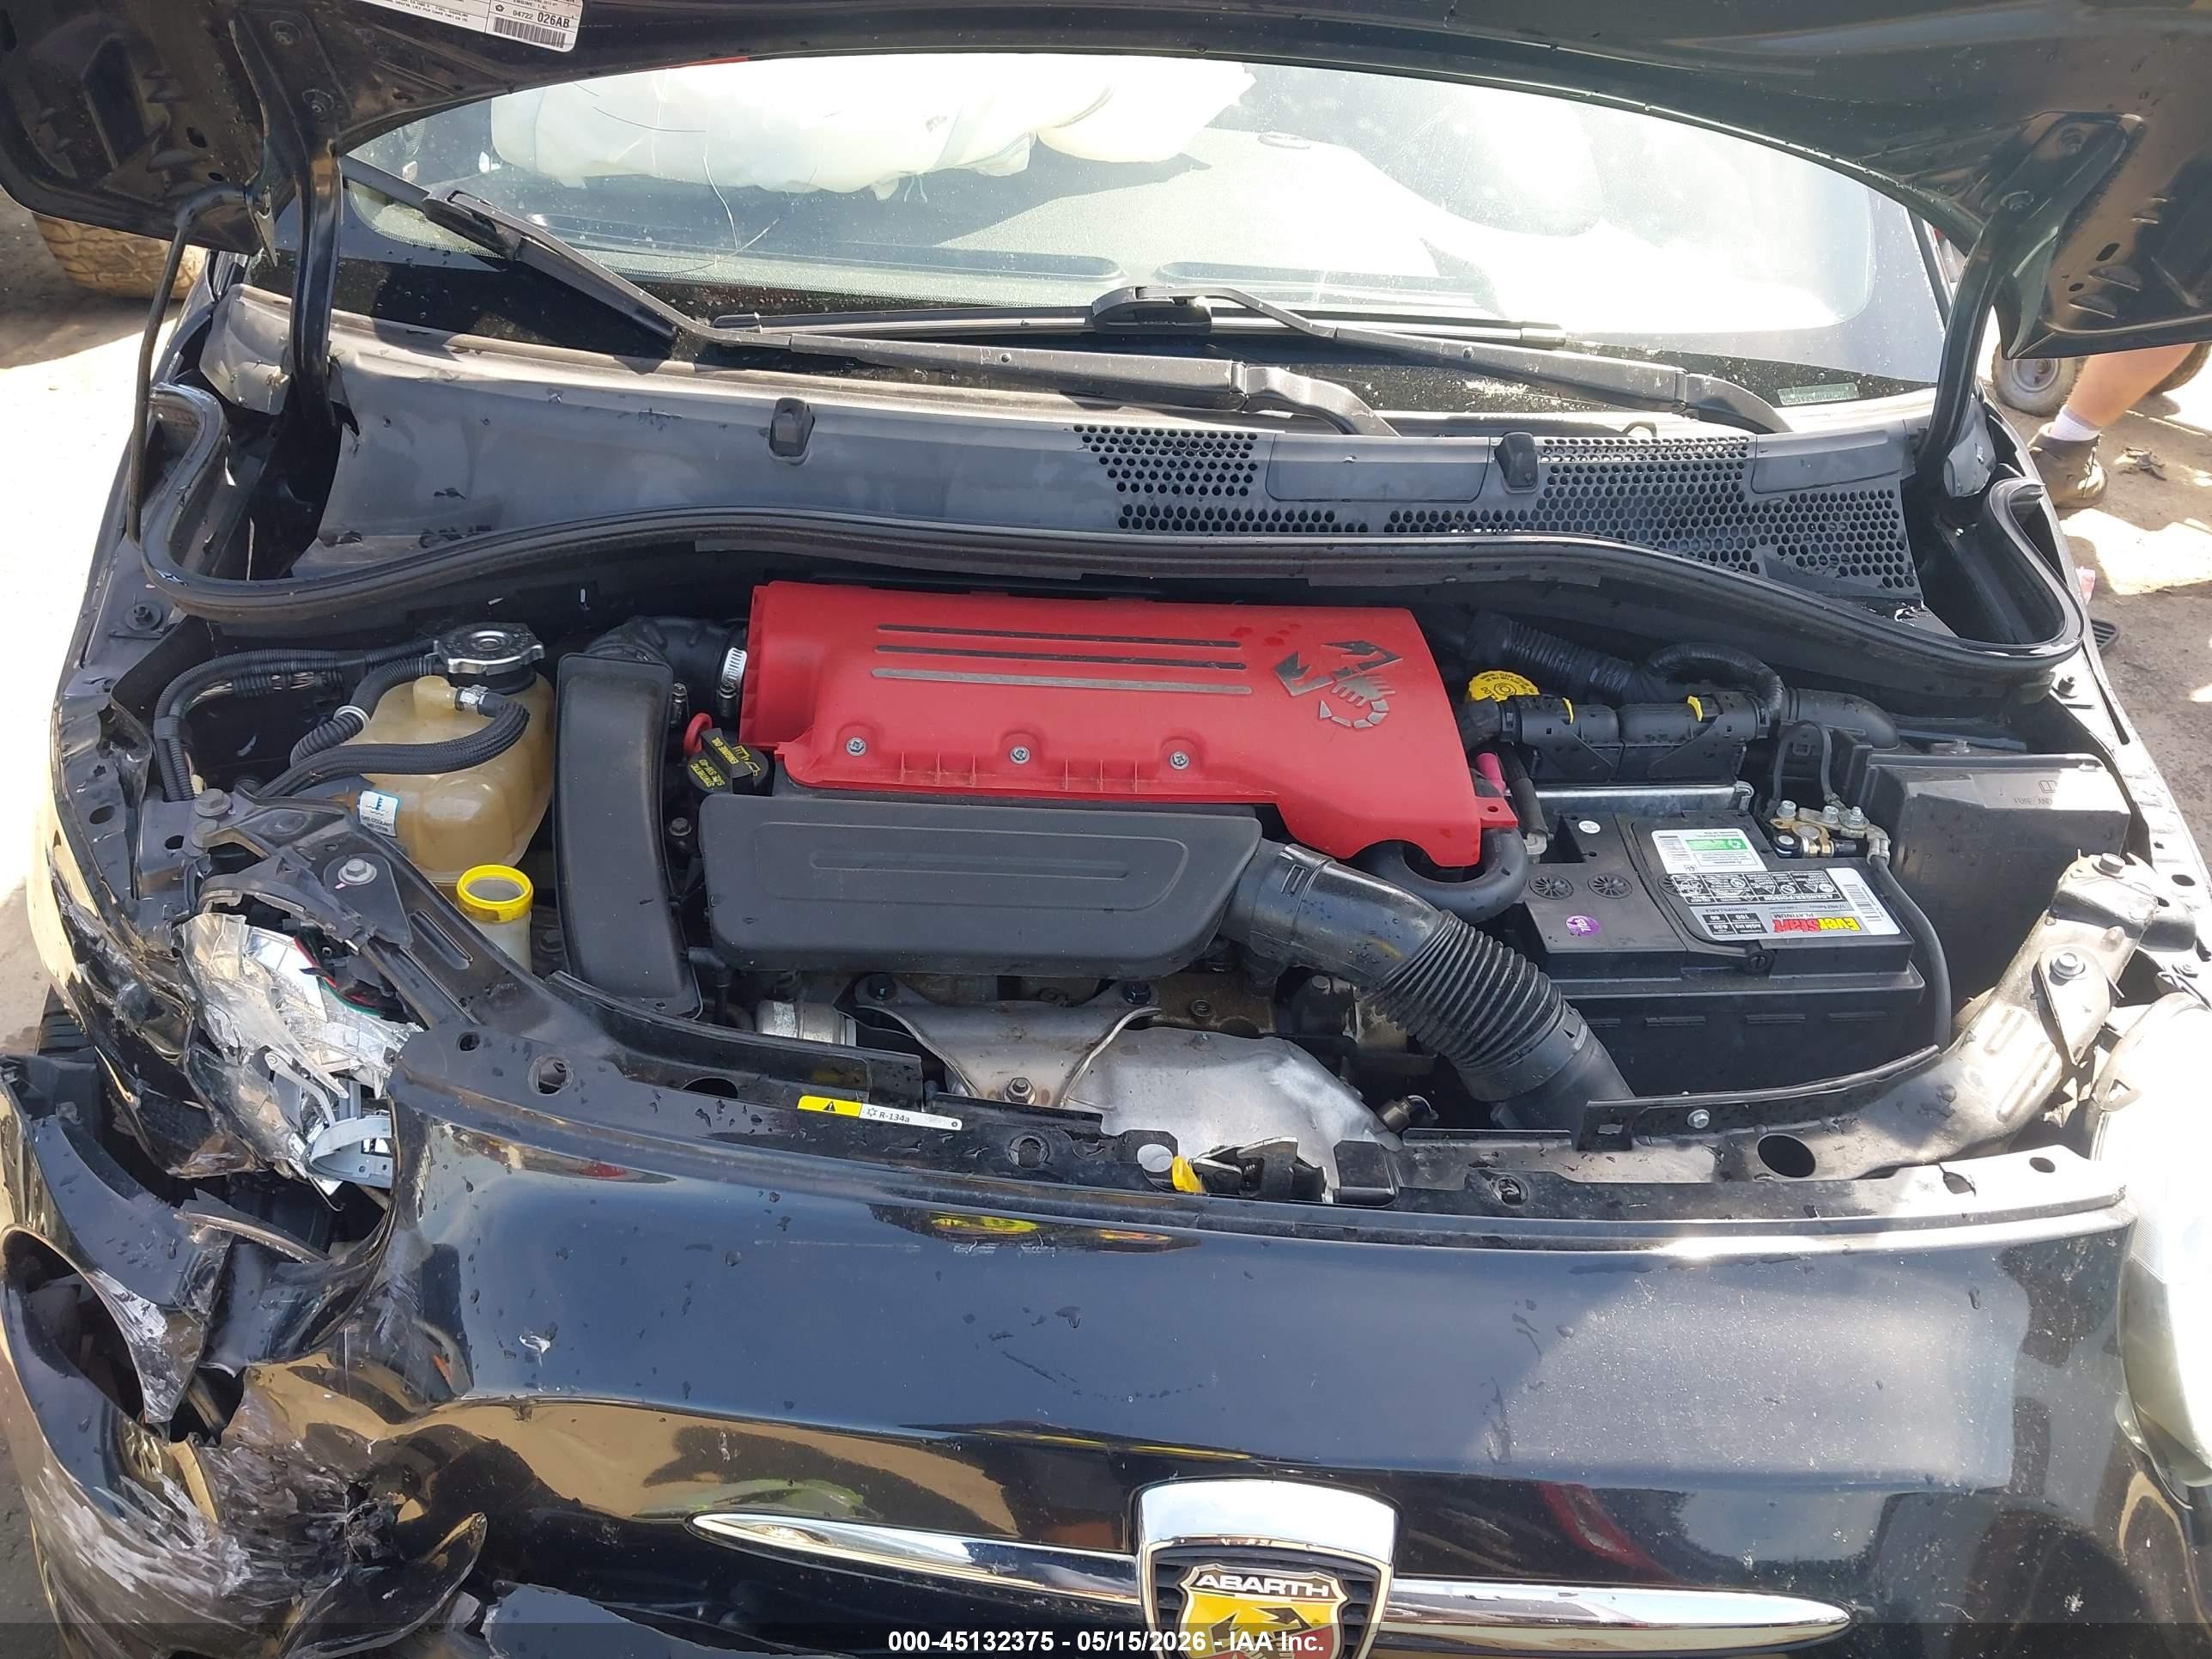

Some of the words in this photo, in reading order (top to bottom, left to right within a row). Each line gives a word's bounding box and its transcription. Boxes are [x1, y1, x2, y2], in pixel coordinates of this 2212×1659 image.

[513, 9, 534, 20] 04722
[537, 12, 570, 28] 026AB
[711, 737, 724, 747] OIL
[718, 744, 739, 764] ENGINE
[1772, 917, 1862, 933] EverStart
[878, 1111, 910, 1123] R-134a
[1195, 1575, 1329, 1597] ABARTH
